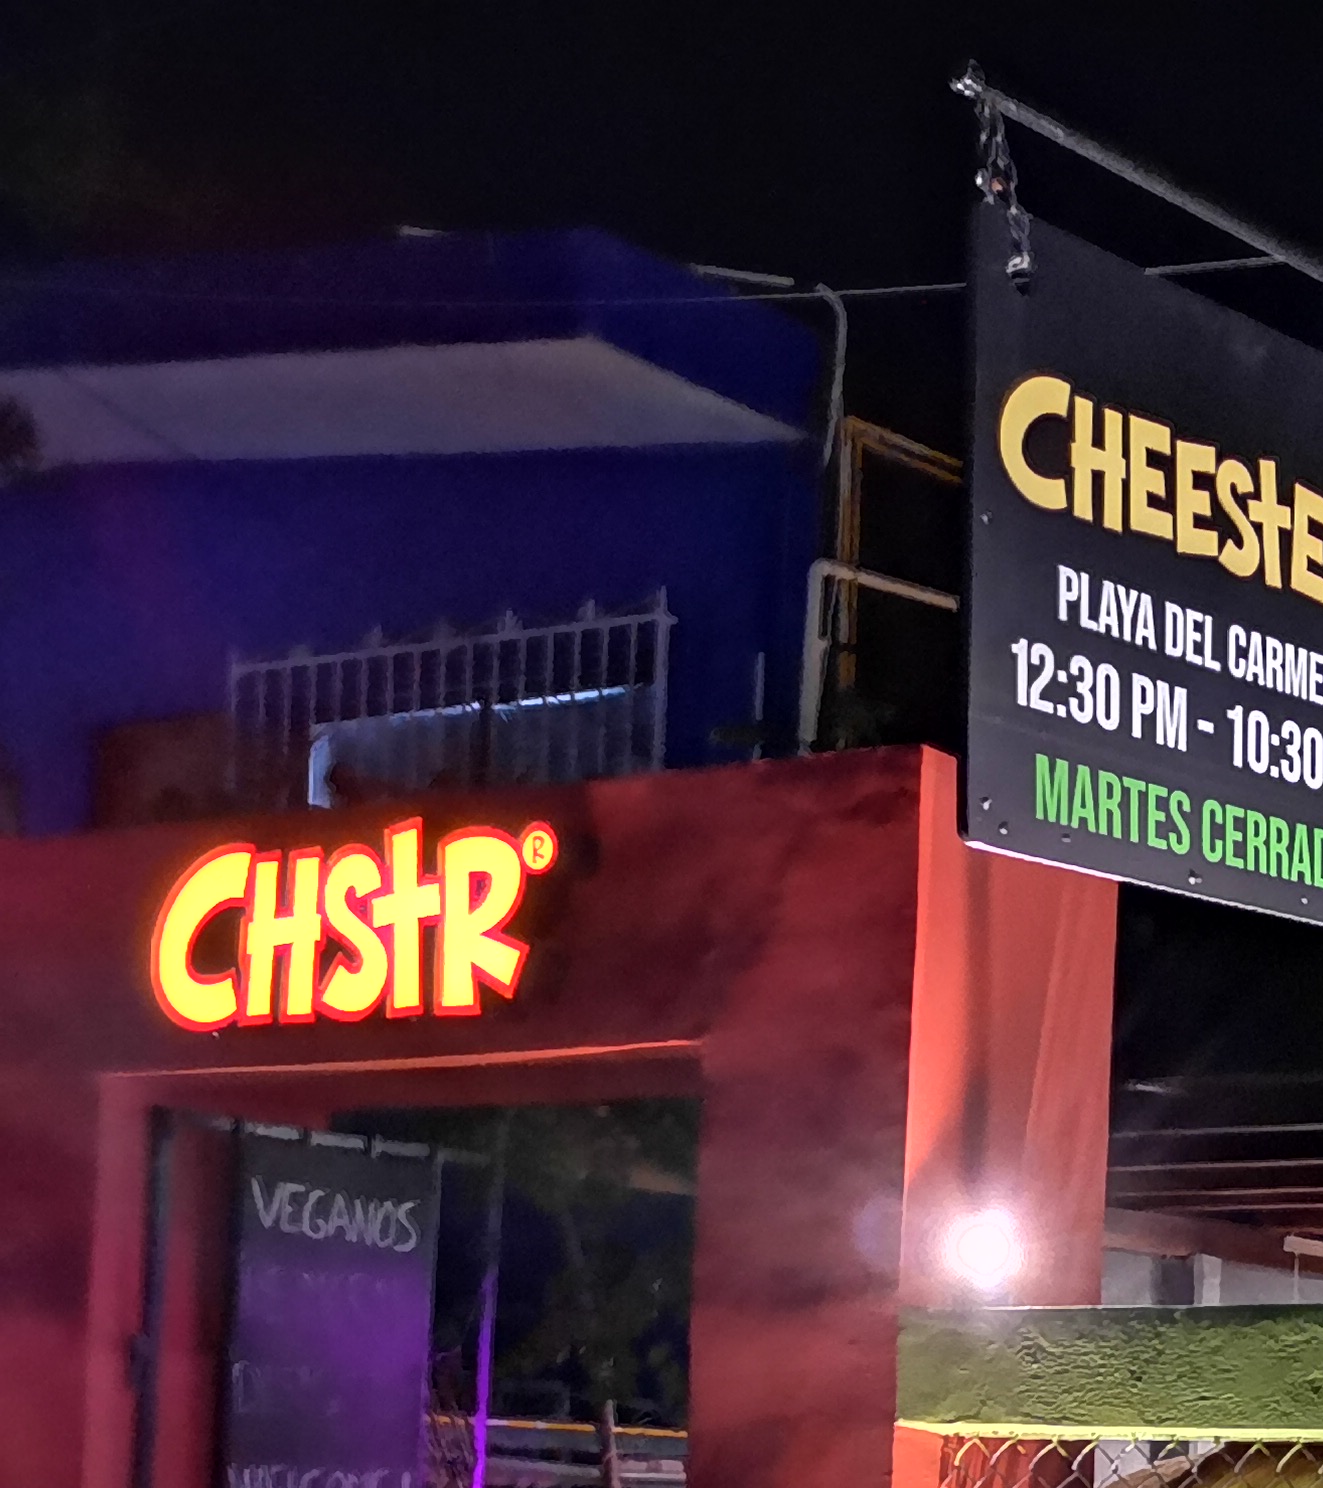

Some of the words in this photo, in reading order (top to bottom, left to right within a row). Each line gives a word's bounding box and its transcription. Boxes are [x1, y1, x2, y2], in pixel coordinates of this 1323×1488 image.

[1057, 564, 1158, 653] PLAYA
[1165, 597, 1222, 674] DEL
[1011, 638, 1120, 731] 12:30
[1131, 673, 1189, 753] PM
[1034, 752, 1192, 857] MARTES
[250, 1174, 420, 1253] VEGANOS
